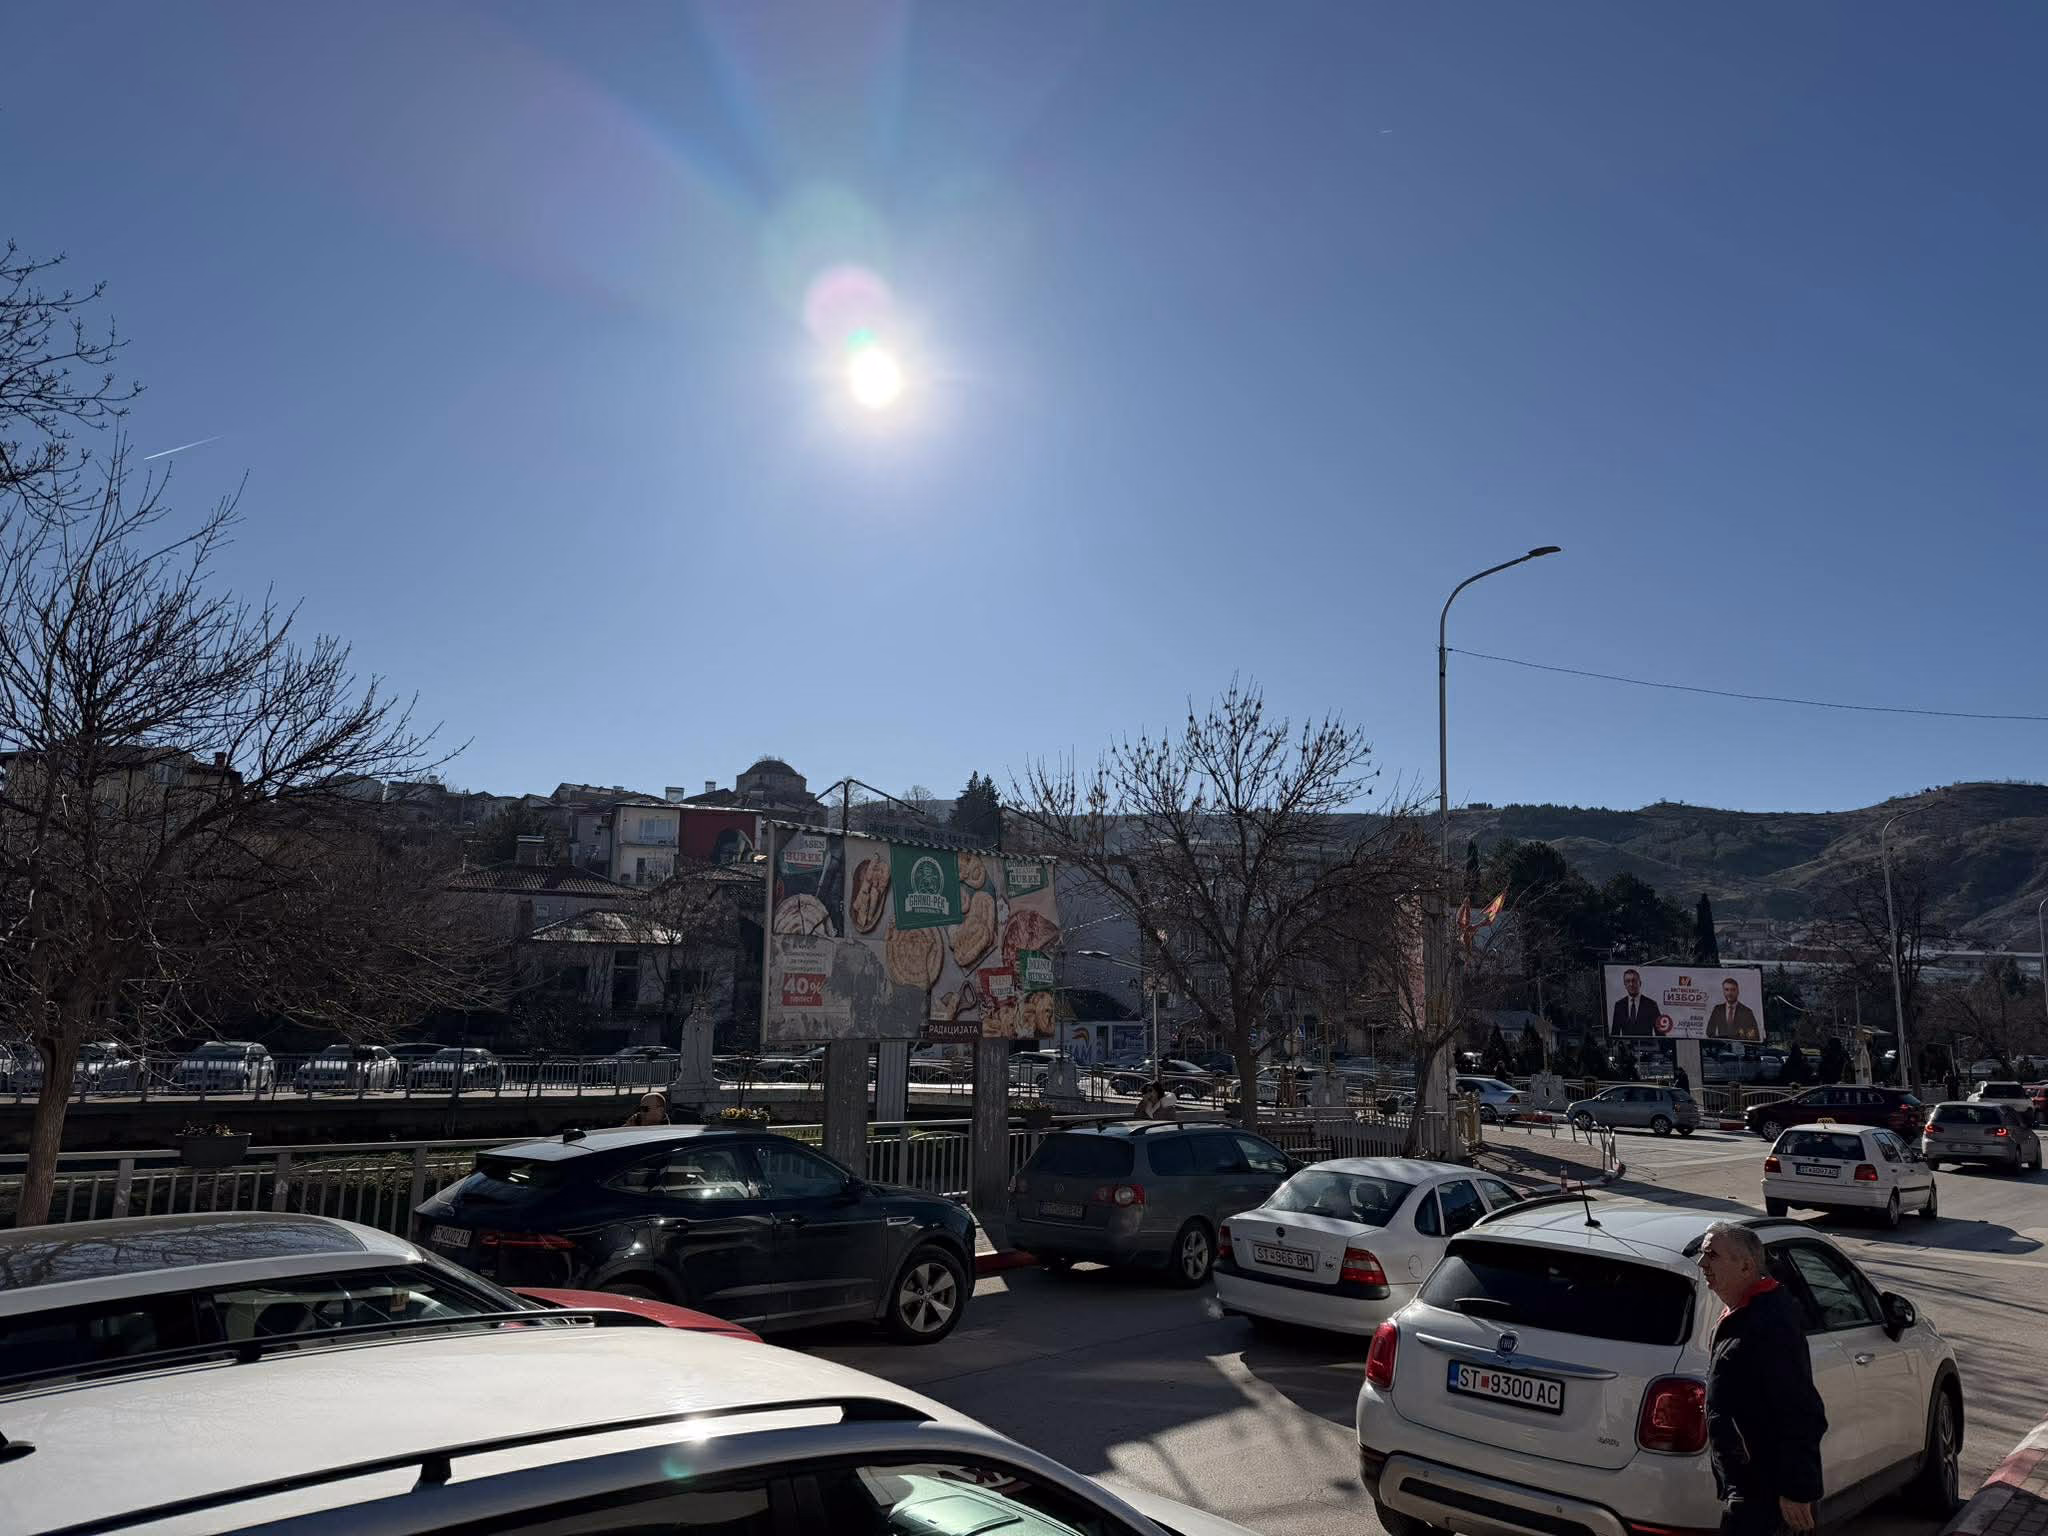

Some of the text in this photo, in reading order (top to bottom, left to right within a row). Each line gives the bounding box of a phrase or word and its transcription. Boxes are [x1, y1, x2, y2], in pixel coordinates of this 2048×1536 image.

[785, 851, 822, 862] BUREK
[1667, 994, 1703, 1002] ИЗБОР
[1660, 1017, 1670, 1031] 9
[1257, 1248, 1268, 1260] ST
[1460, 1367, 1558, 1404] ST 9300 AC
